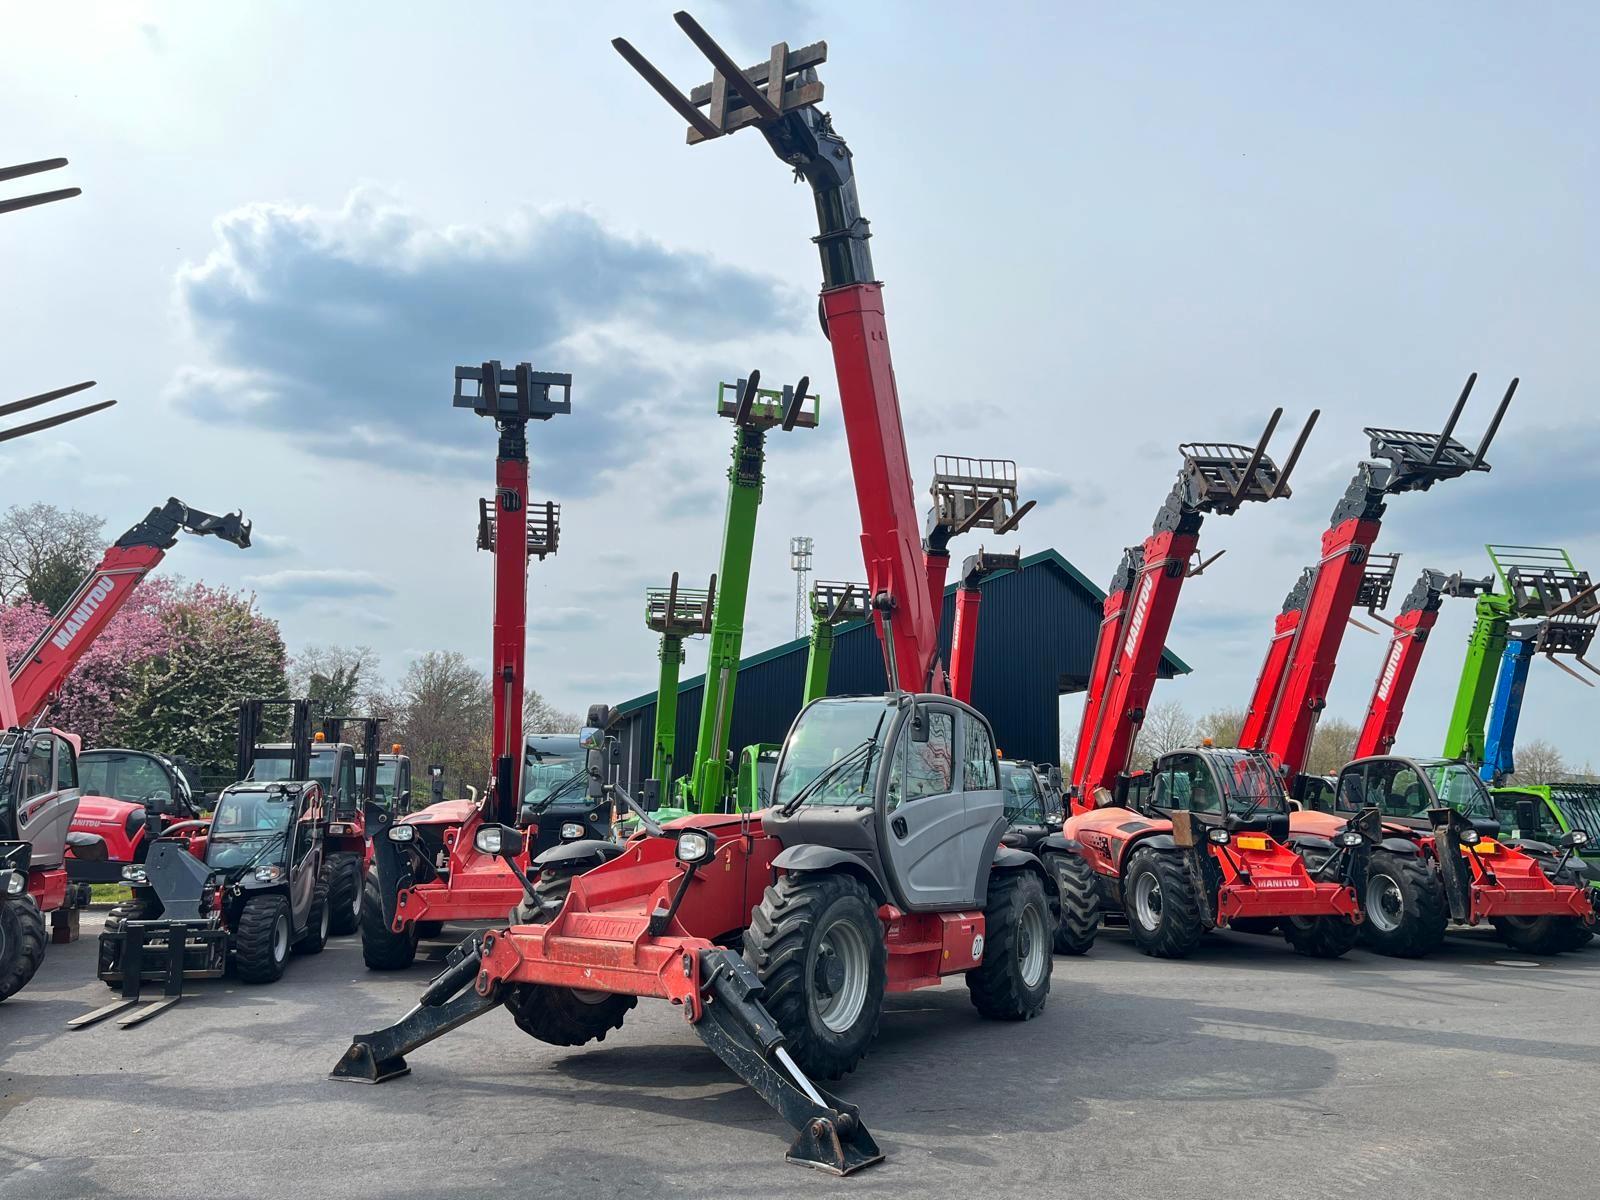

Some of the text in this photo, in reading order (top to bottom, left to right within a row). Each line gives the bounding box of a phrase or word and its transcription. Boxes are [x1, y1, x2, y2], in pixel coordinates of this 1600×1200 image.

[51, 576, 115, 651] MANITOU
[1124, 572, 1153, 659] MANITOU
[1377, 640, 1404, 702] MANITOU
[70, 819, 101, 828] ANITOU
[1258, 879, 1300, 888] MANITOU
[973, 938, 983, 956] 20
